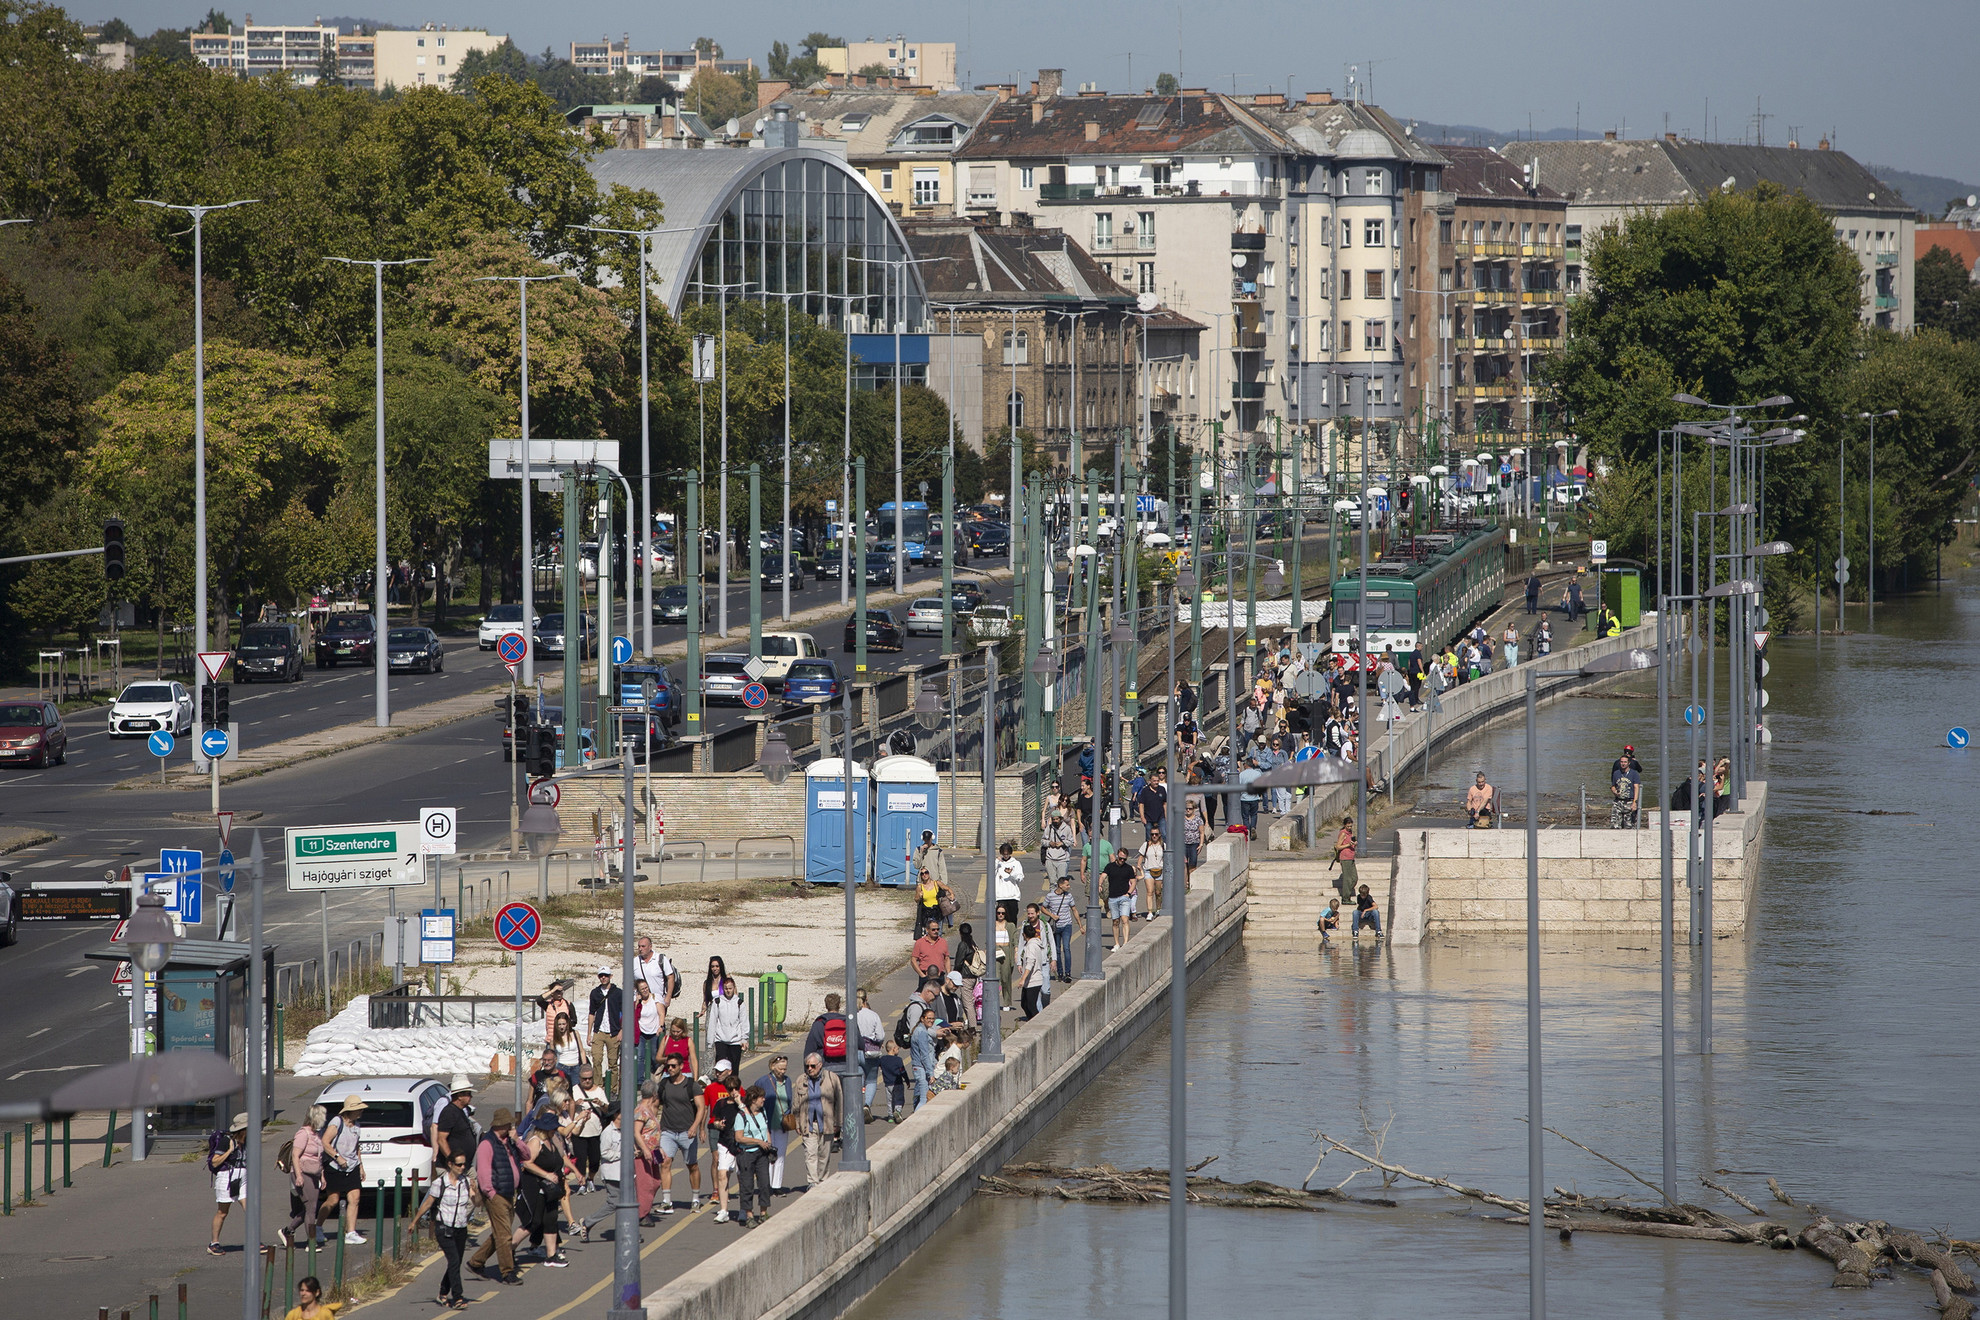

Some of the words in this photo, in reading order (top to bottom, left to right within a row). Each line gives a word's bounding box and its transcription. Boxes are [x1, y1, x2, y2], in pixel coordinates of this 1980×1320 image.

[308, 841, 318, 850] 11
[326, 838, 390, 851] Szentendre
[302, 868, 357, 884] Hajógyári
[359, 867, 392, 882] sziget
